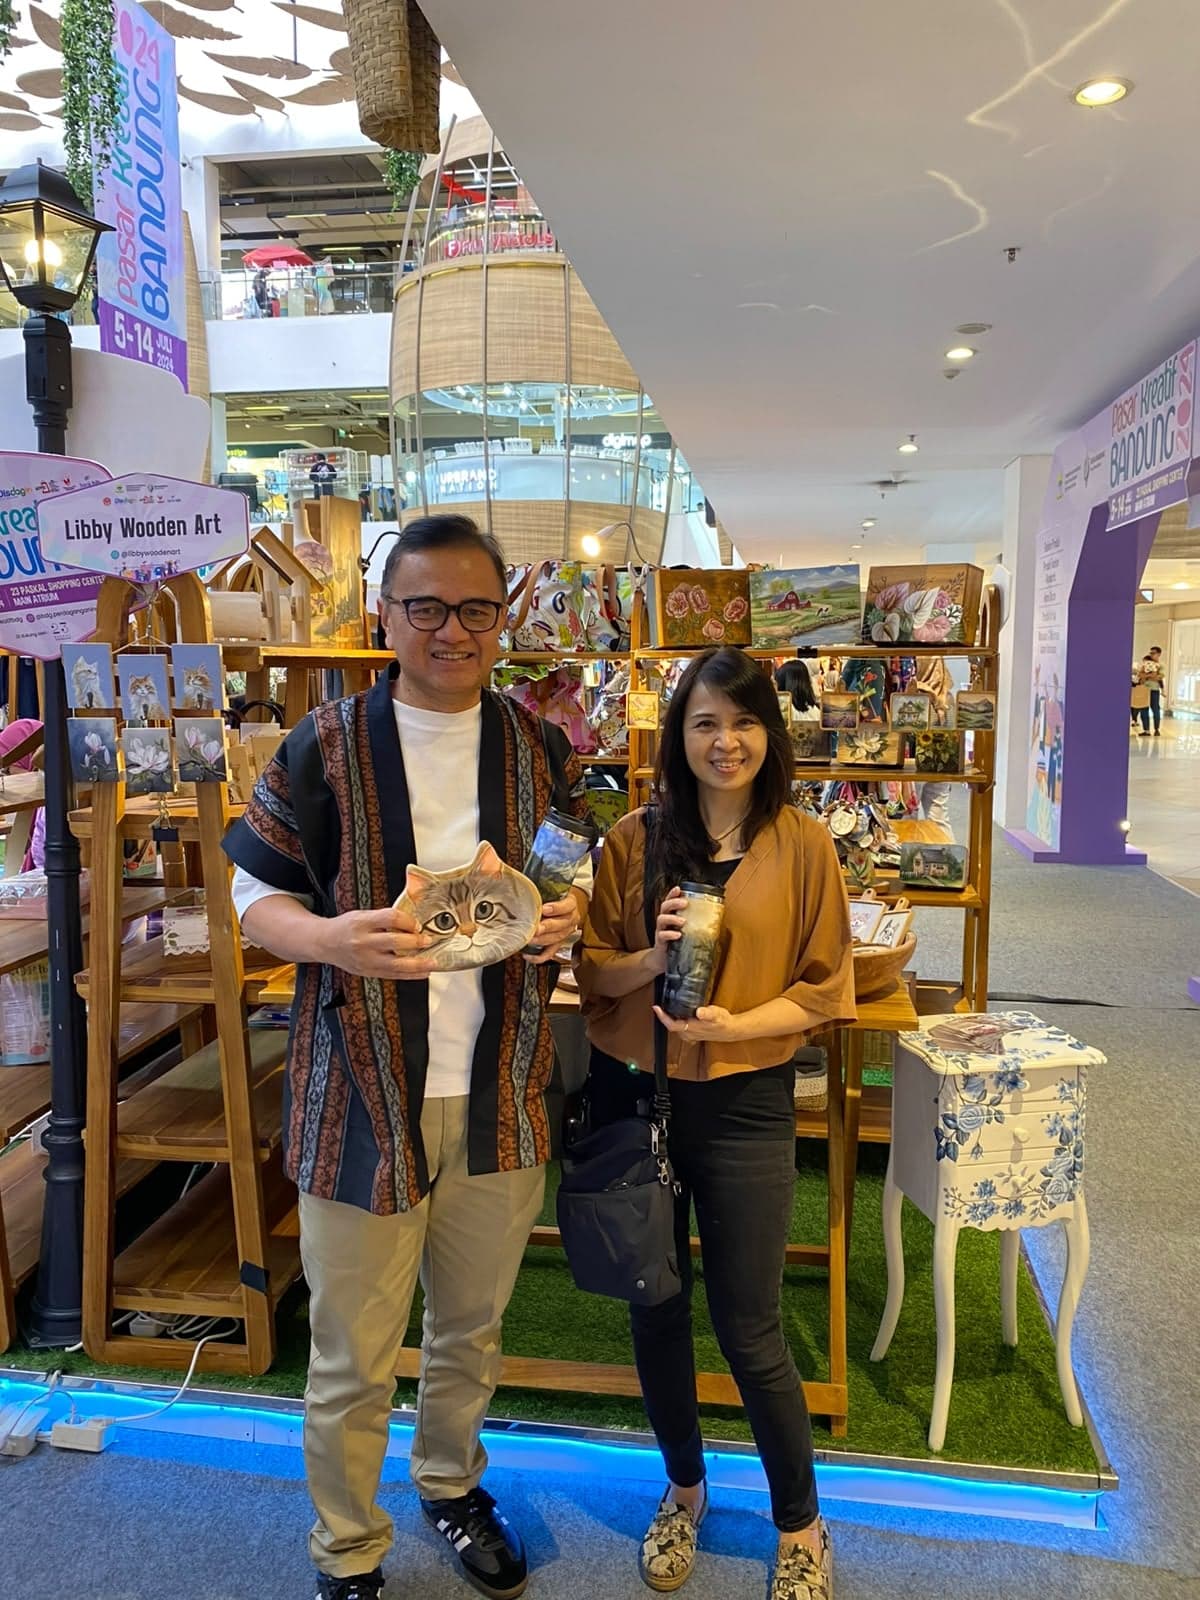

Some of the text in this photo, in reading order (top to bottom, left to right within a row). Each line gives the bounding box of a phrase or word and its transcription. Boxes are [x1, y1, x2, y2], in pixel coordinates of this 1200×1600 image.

[133, 67, 170, 321] BANDUNG
[114, 311, 173, 362] 5-14 JULI
[157, 352, 174, 373] 2024
[1140, 355, 1177, 418] Kreatif
[602, 432, 652, 449] digimp
[1110, 405, 1175, 488] BANDUNG
[65, 513, 222, 544] Libby Wooden Art
[13, 595, 32, 606] MAIN
[33, 592, 60, 603] ATRIUM
[20, 583, 48, 595] PASKAL
[48, 578, 81, 591] SHOPPING
